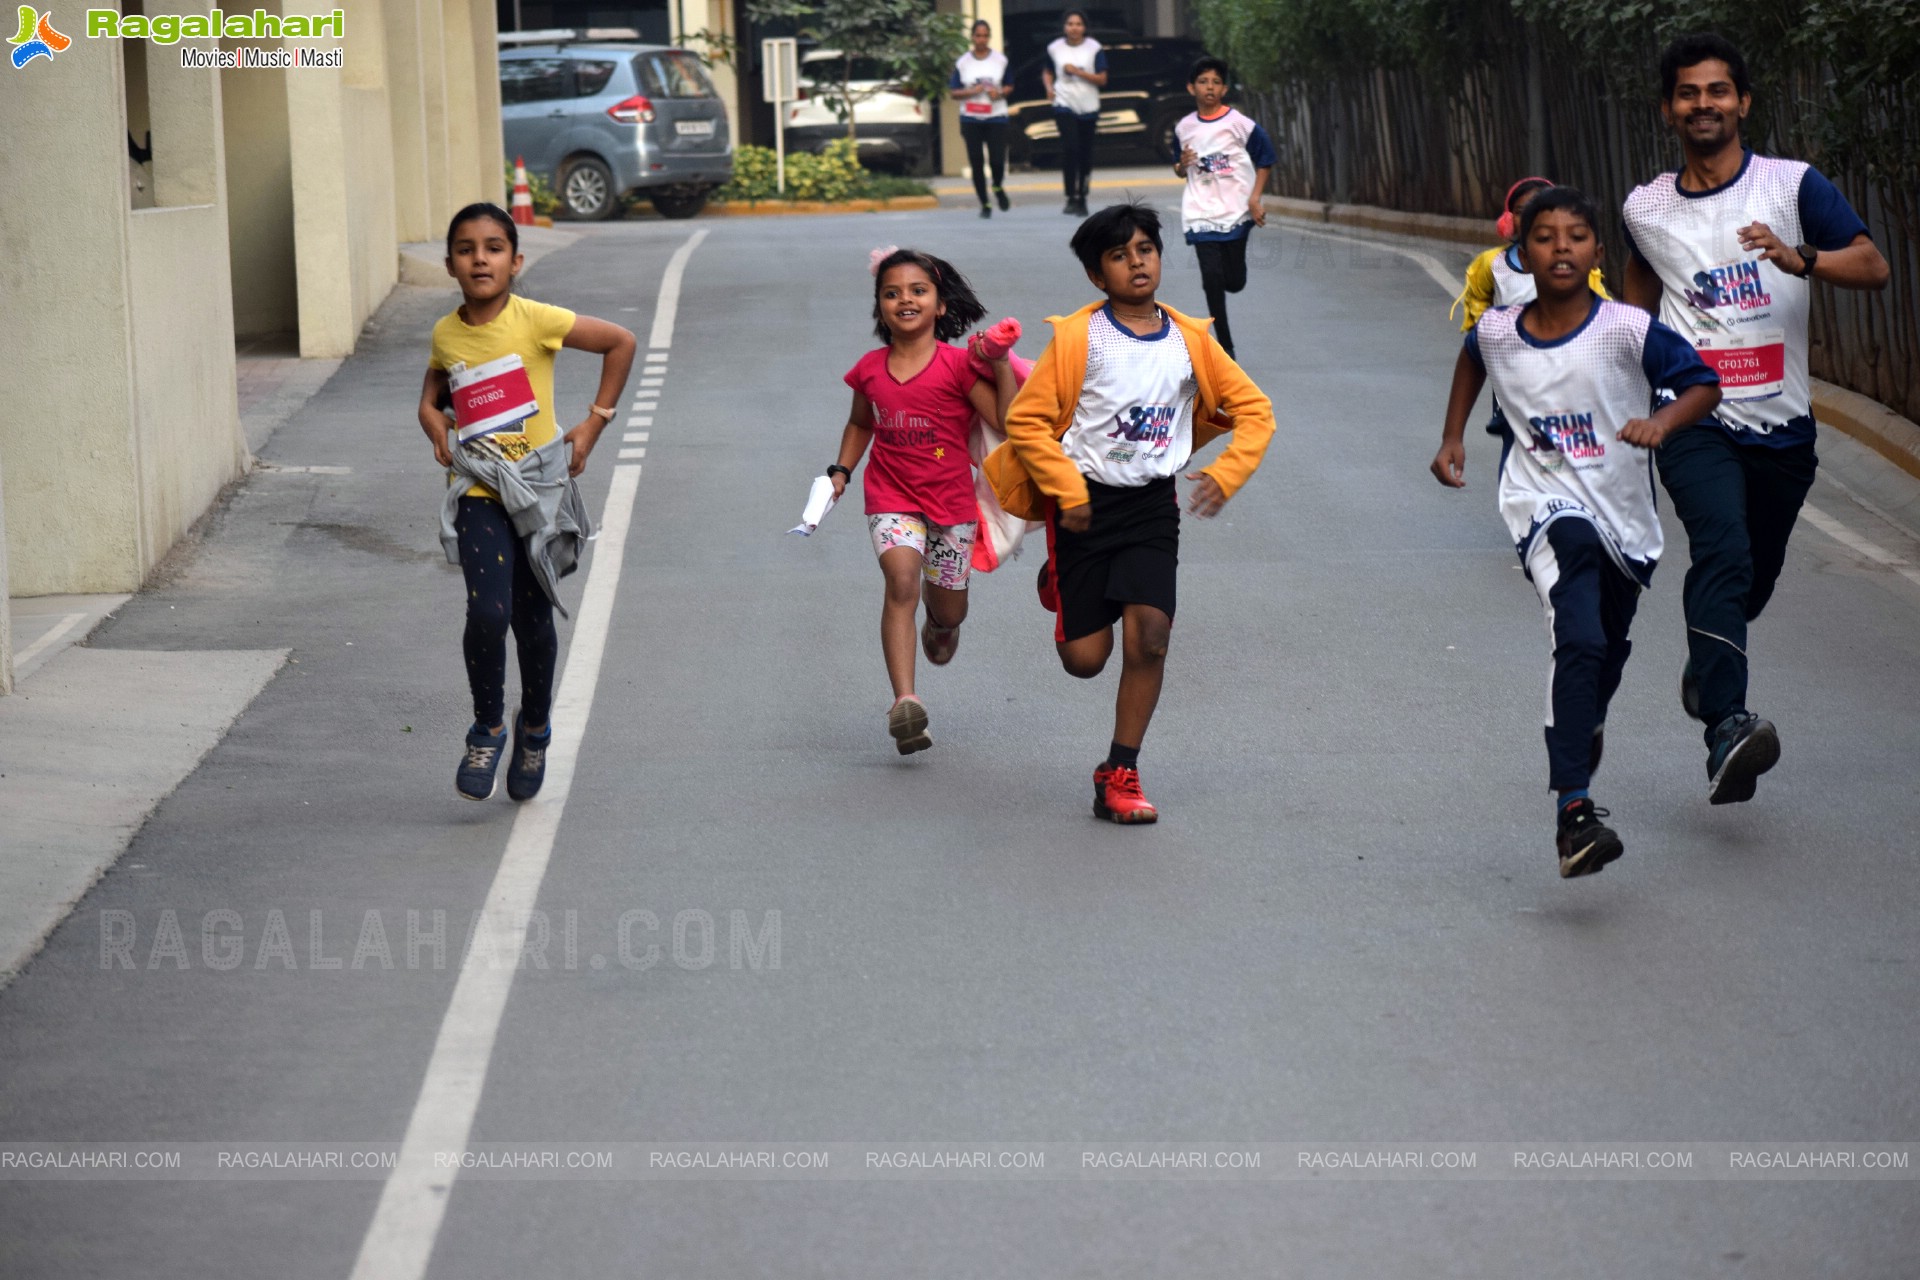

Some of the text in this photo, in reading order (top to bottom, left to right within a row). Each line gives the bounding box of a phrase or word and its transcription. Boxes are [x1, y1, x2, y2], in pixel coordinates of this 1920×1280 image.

[1710, 260, 1759, 288] RUN
[1714, 279, 1763, 306] GIRL
[1740, 293, 1771, 310] CHILD
[1718, 357, 1760, 370] CF01761
[467, 389, 506, 409] CF01802
[909, 416, 930, 428] me
[1545, 412, 1593, 435] RUN
[1138, 423, 1169, 442] GIR
[1573, 444, 1605, 459] CHILD
